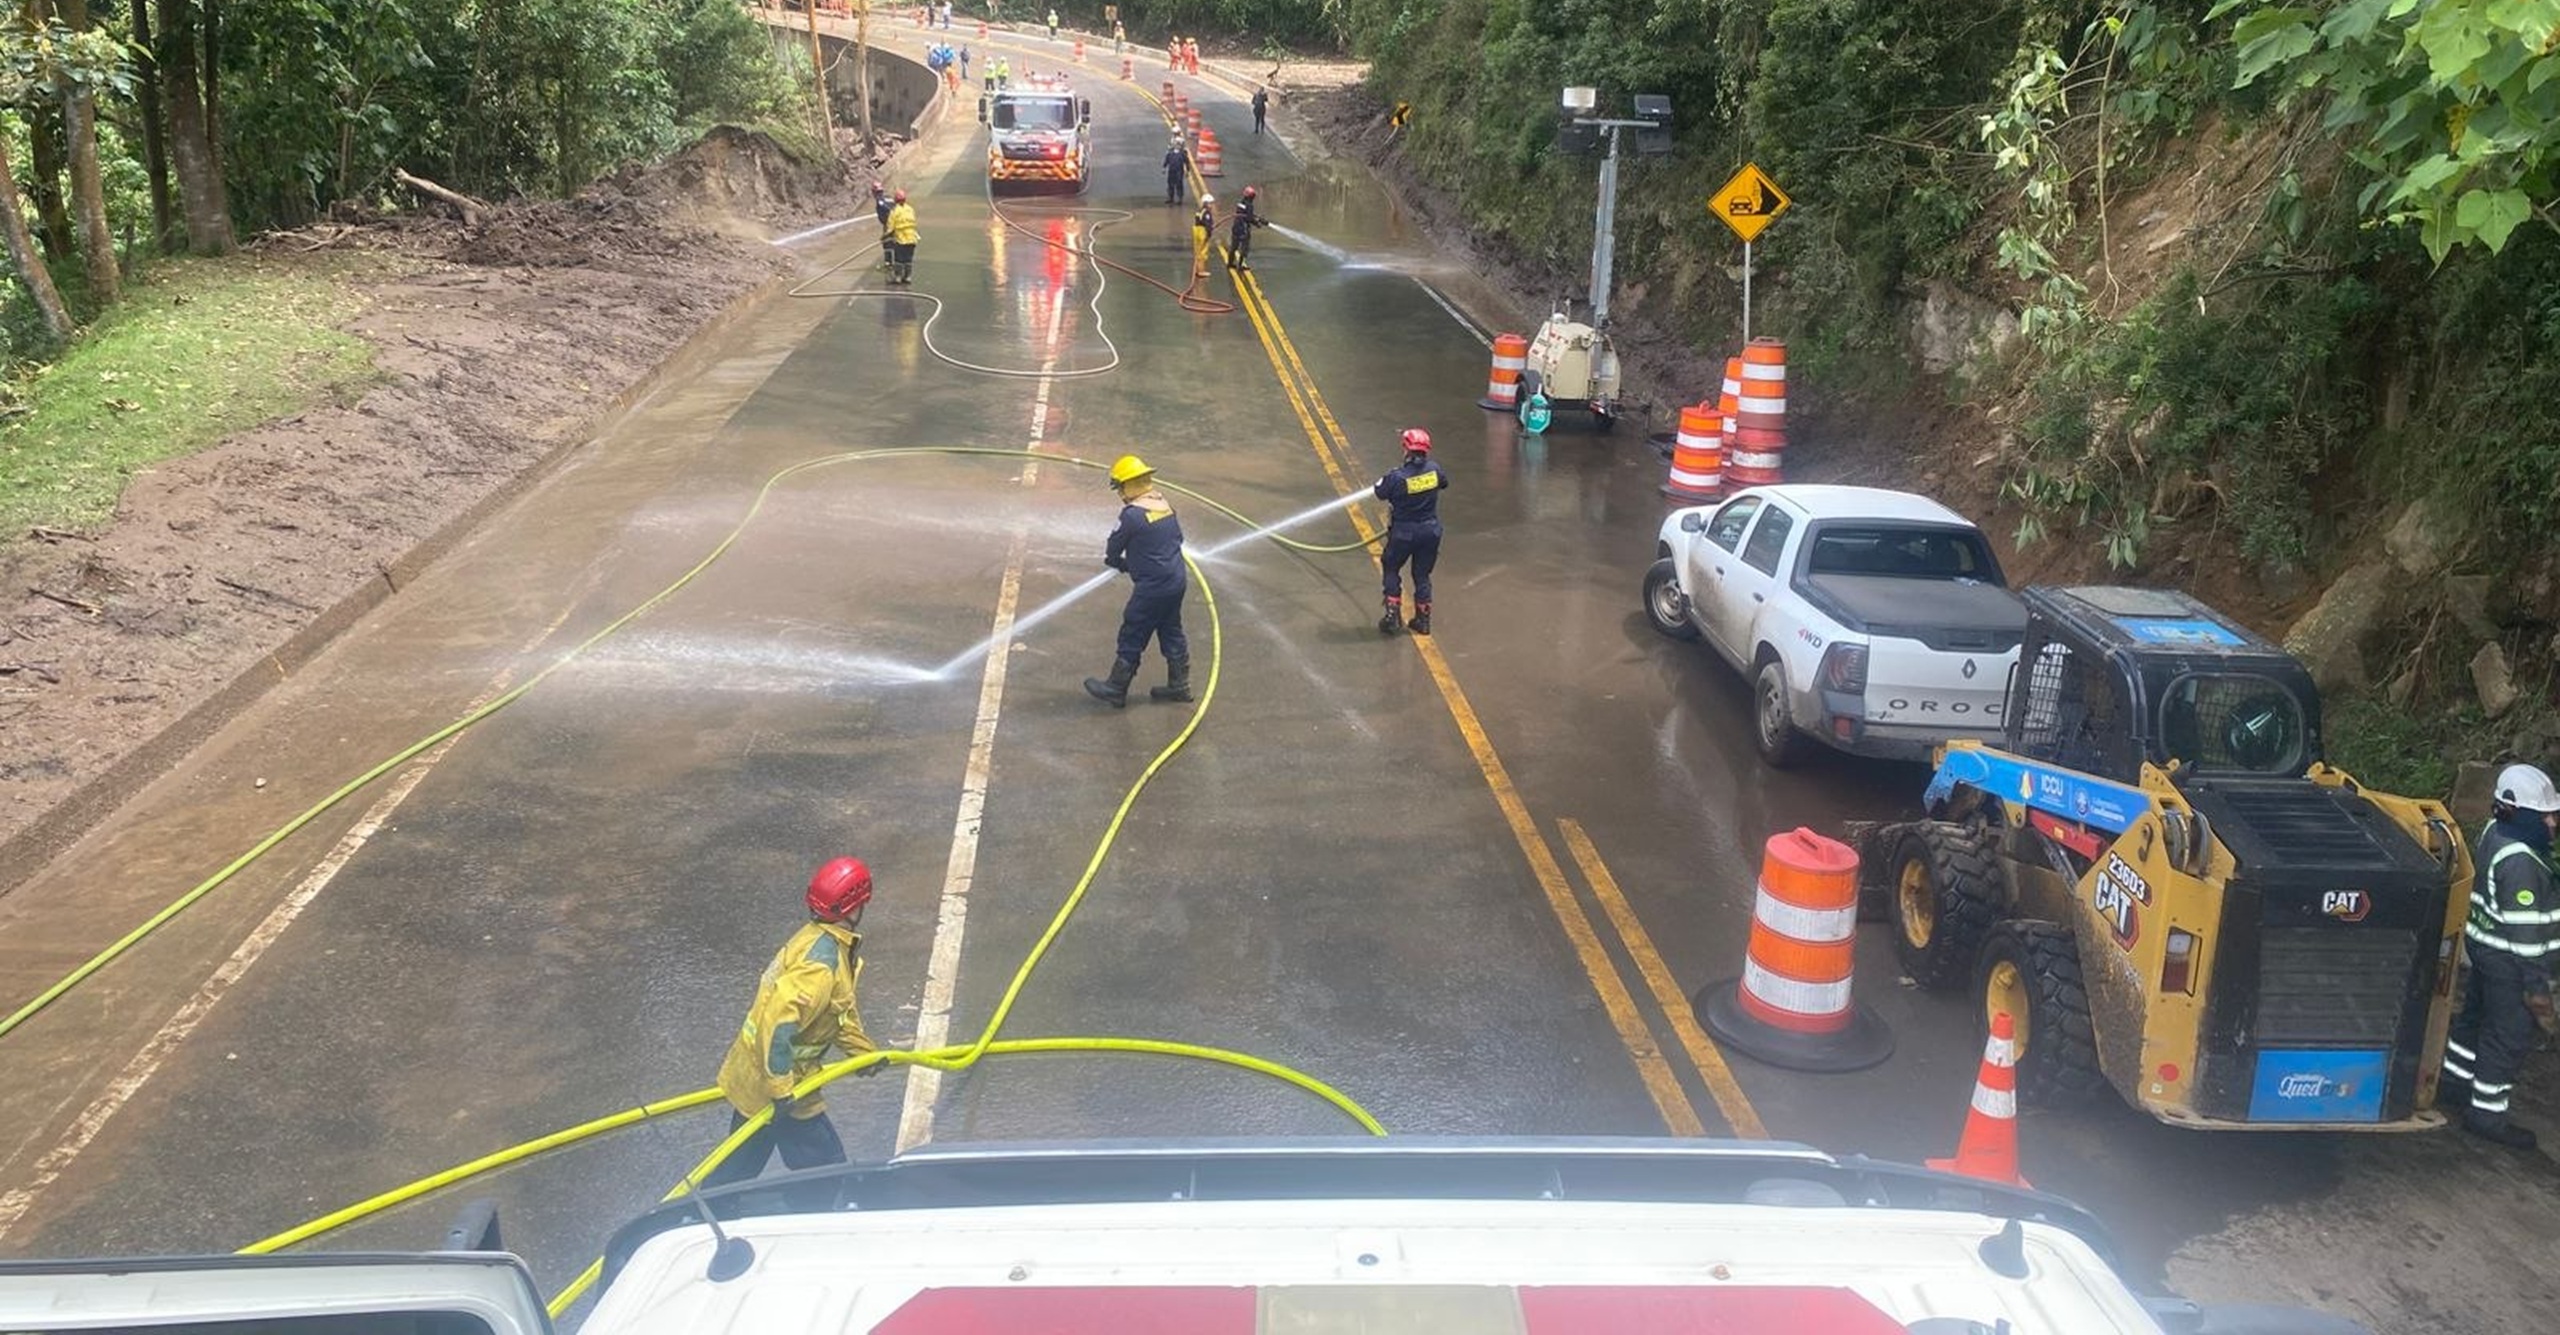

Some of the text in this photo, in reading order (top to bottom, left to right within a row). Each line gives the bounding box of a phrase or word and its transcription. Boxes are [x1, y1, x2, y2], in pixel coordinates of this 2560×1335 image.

[1797, 627, 1823, 649] 4WD
[2107, 852, 2147, 901] 236D3
[2095, 870, 2133, 935] CAT
[2323, 890, 2360, 913] CAT
